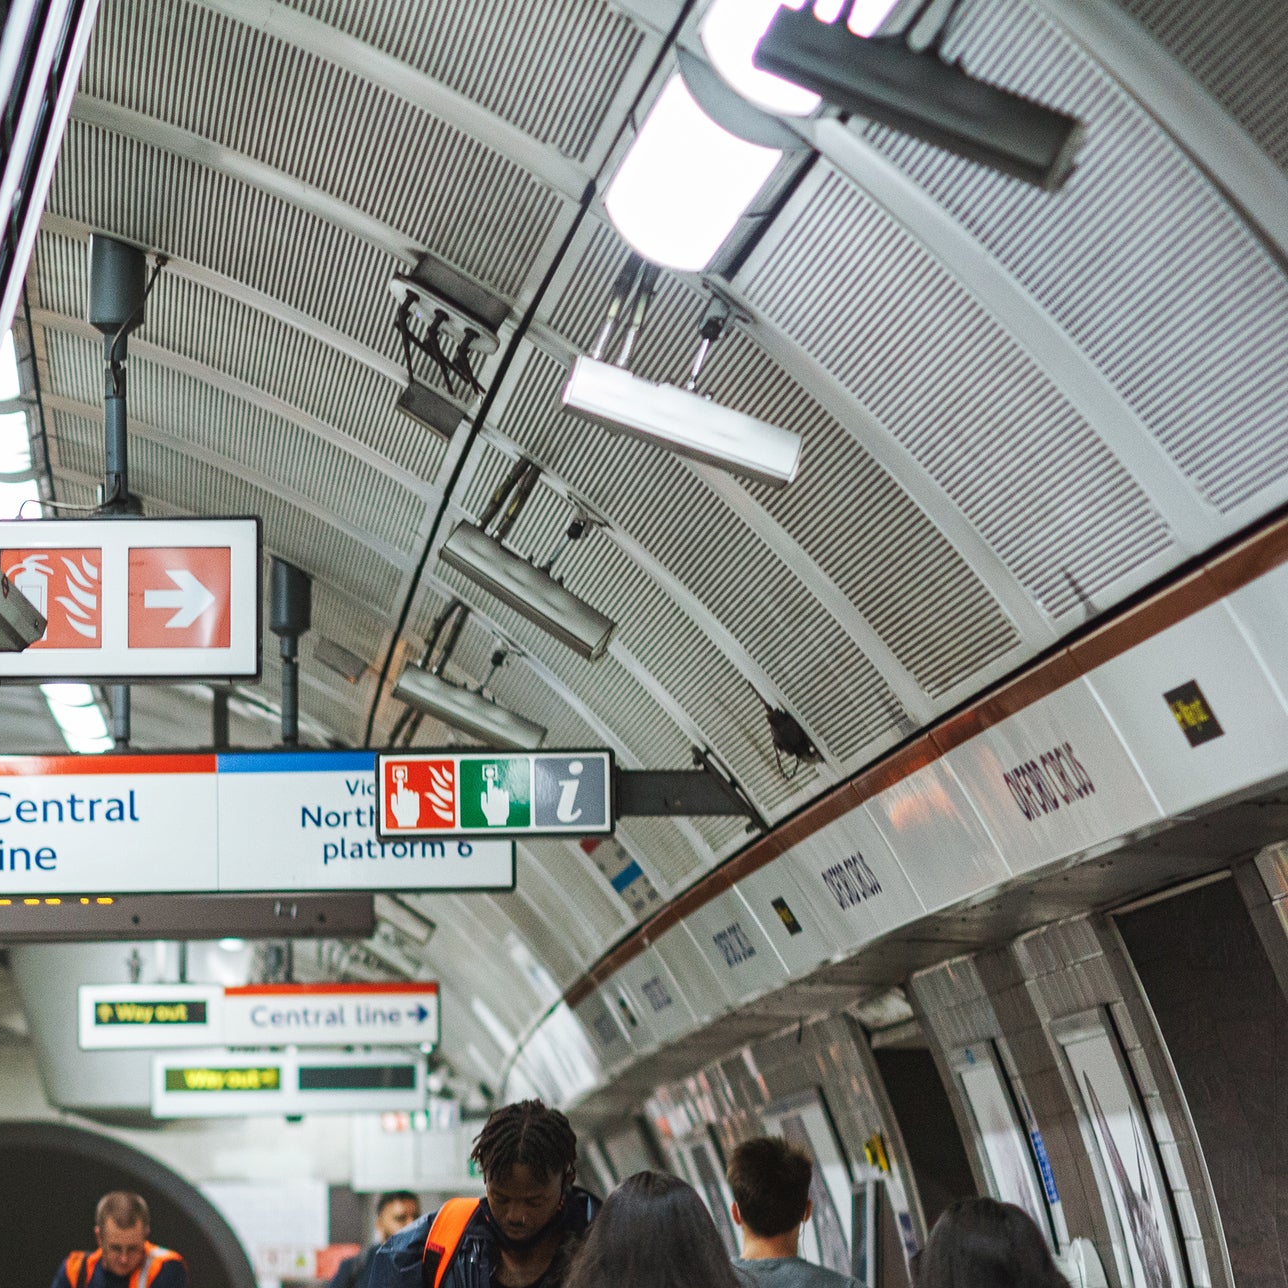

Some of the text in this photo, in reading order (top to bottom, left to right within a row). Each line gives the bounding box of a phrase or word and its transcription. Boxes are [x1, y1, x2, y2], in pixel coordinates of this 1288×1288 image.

[1003, 741, 1096, 821] OXFORD CIRCUS
[323, 837, 446, 865] platform
[115, 1003, 188, 1025] Way out
[250, 1004, 402, 1027] Central line
[183, 1068, 261, 1091] Way out
